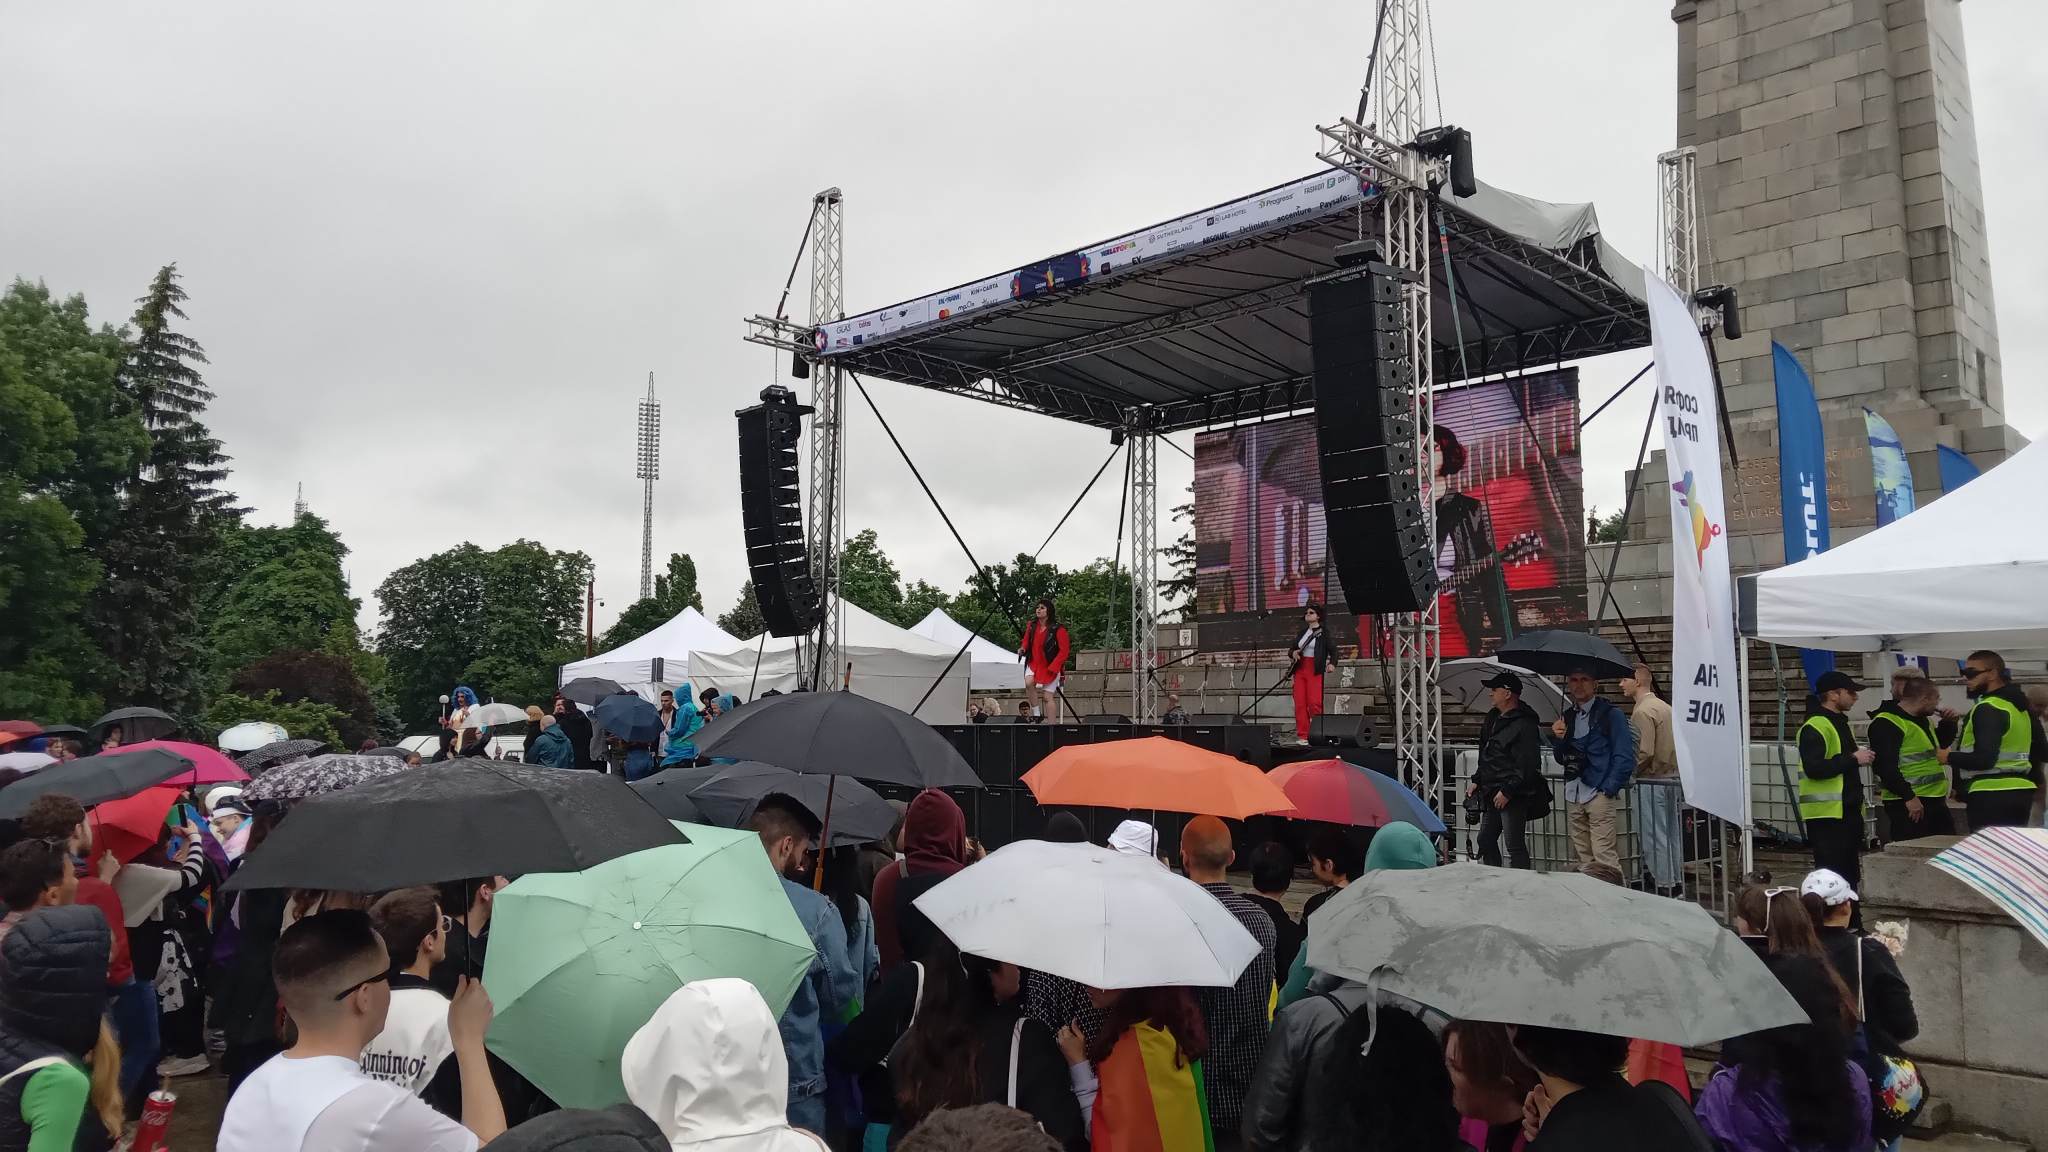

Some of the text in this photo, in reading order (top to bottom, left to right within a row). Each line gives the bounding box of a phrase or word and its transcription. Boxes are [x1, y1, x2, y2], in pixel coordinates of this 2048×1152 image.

[1265, 193, 1295, 208] Progress
[1277, 207, 1312, 223] accenture
[1156, 224, 1193, 240] SUTHERLAND
[1132, 256, 1142, 265] EY
